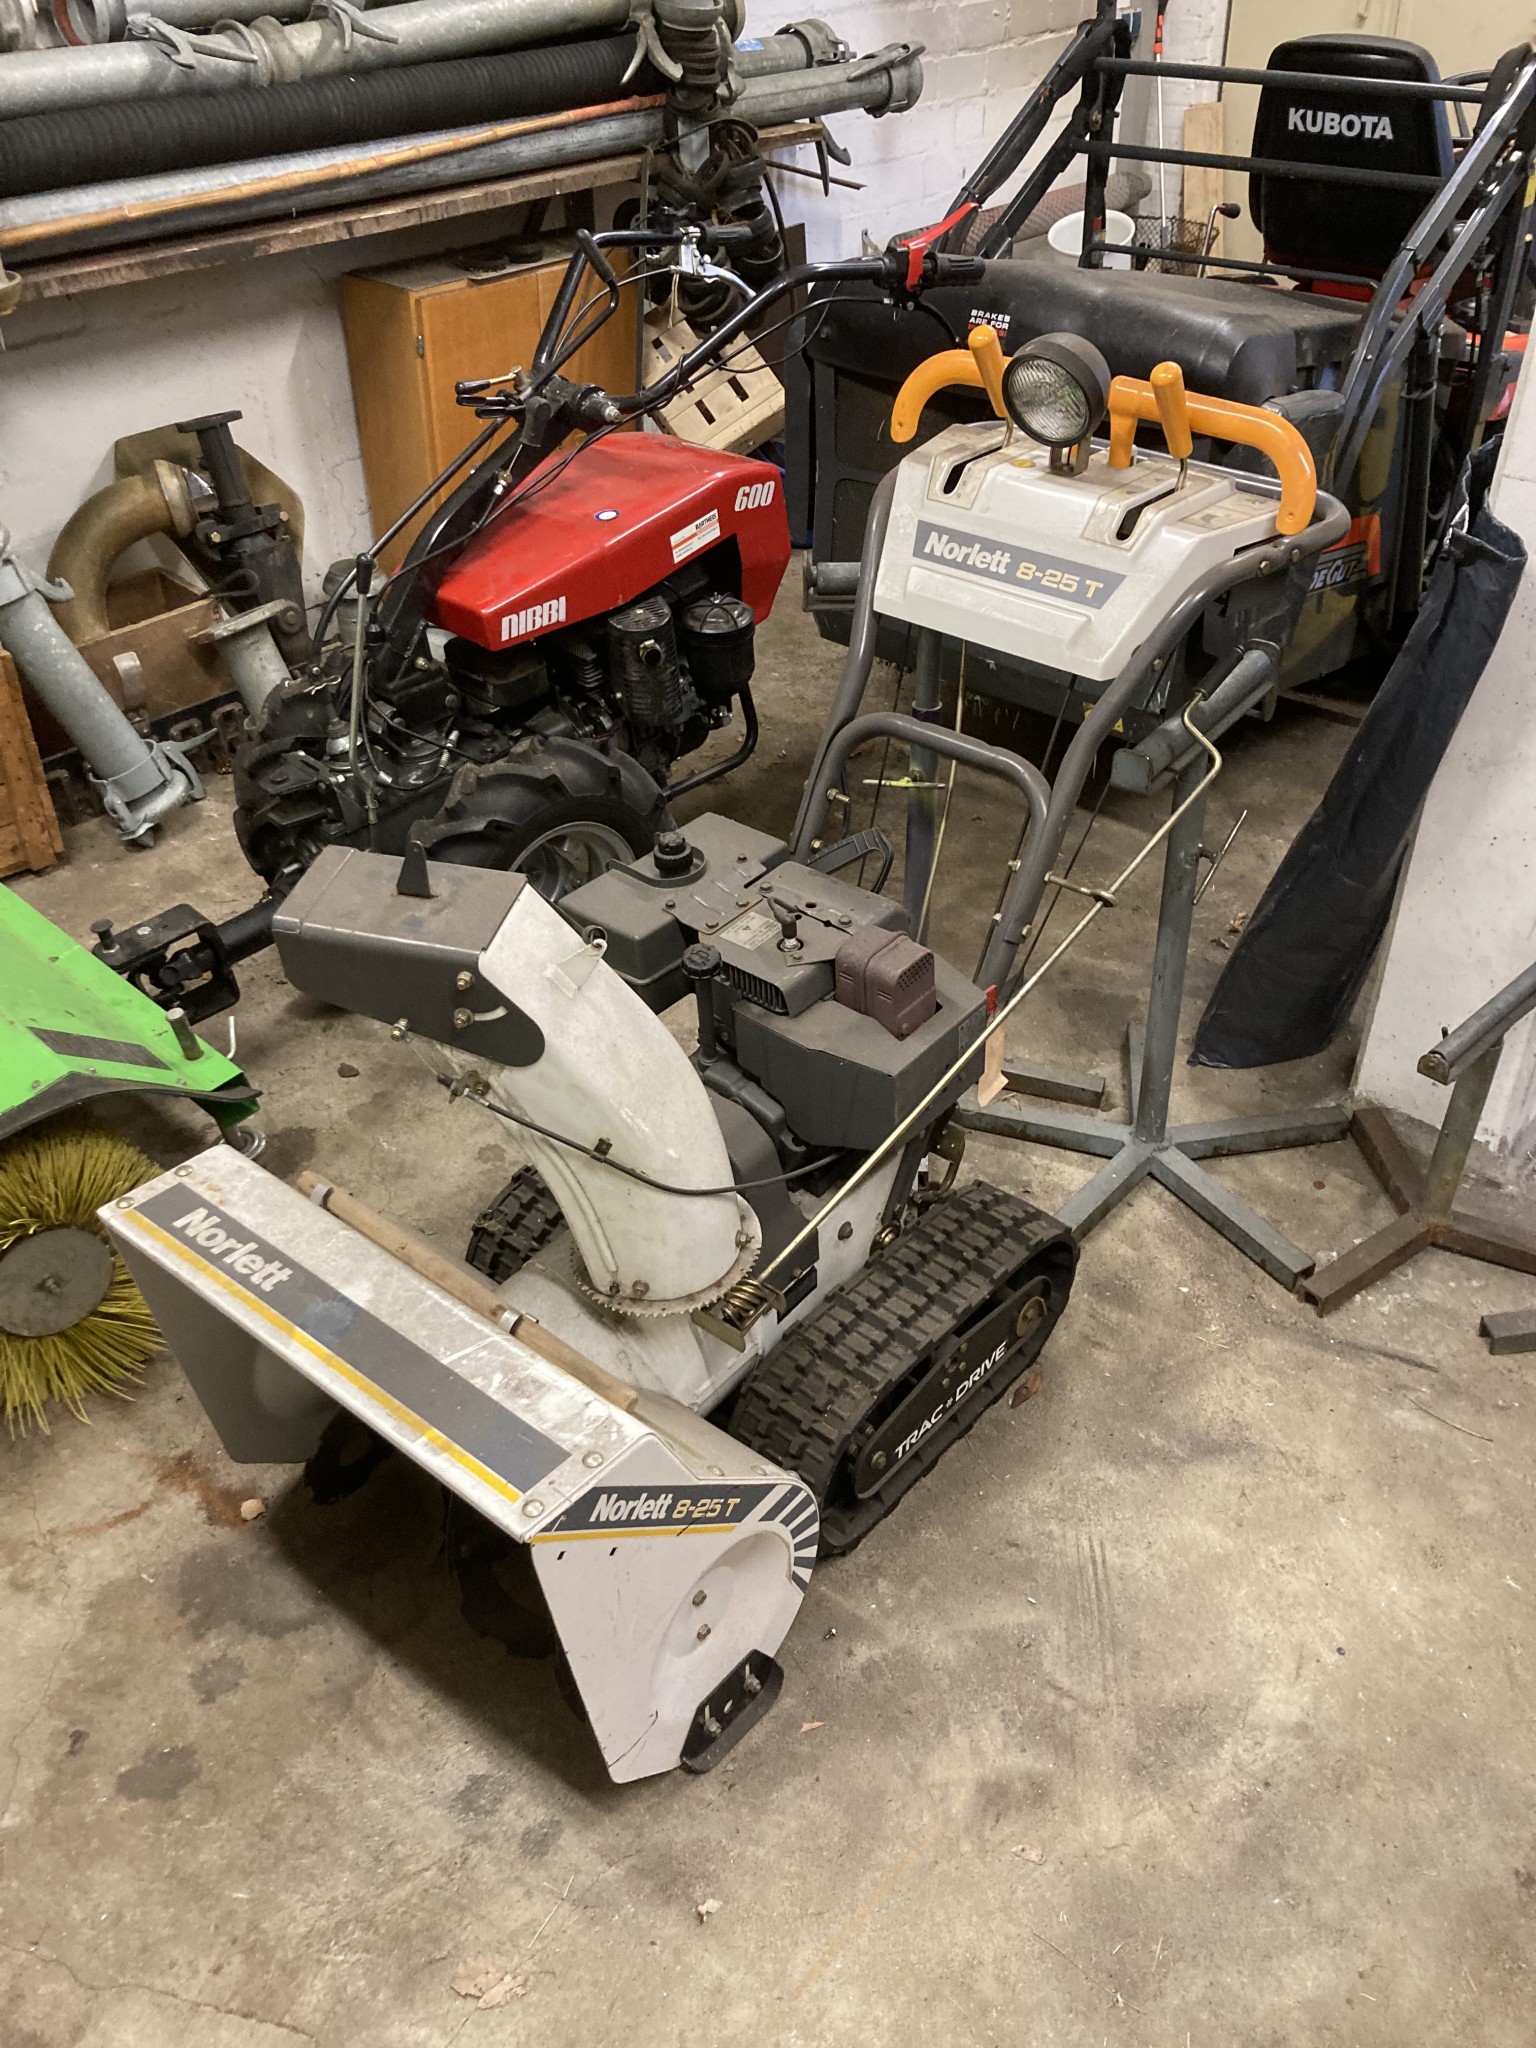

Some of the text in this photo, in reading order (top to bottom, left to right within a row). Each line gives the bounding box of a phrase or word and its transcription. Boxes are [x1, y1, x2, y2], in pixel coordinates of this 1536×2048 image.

[1288, 107, 1394, 139] KUBOTA
[969, 317, 1009, 330] ARE FOR
[971, 309, 1010, 322] BRAKES
[734, 480, 775, 512] 600
[923, 531, 1104, 599] Norlett 8-25 T
[501, 596, 567, 642] NIBBI
[171, 1206, 294, 1292] Norlett
[894, 1340, 1008, 1459] TRAC DRIVE
[589, 1493, 741, 1522] Norlett 8-25 T
